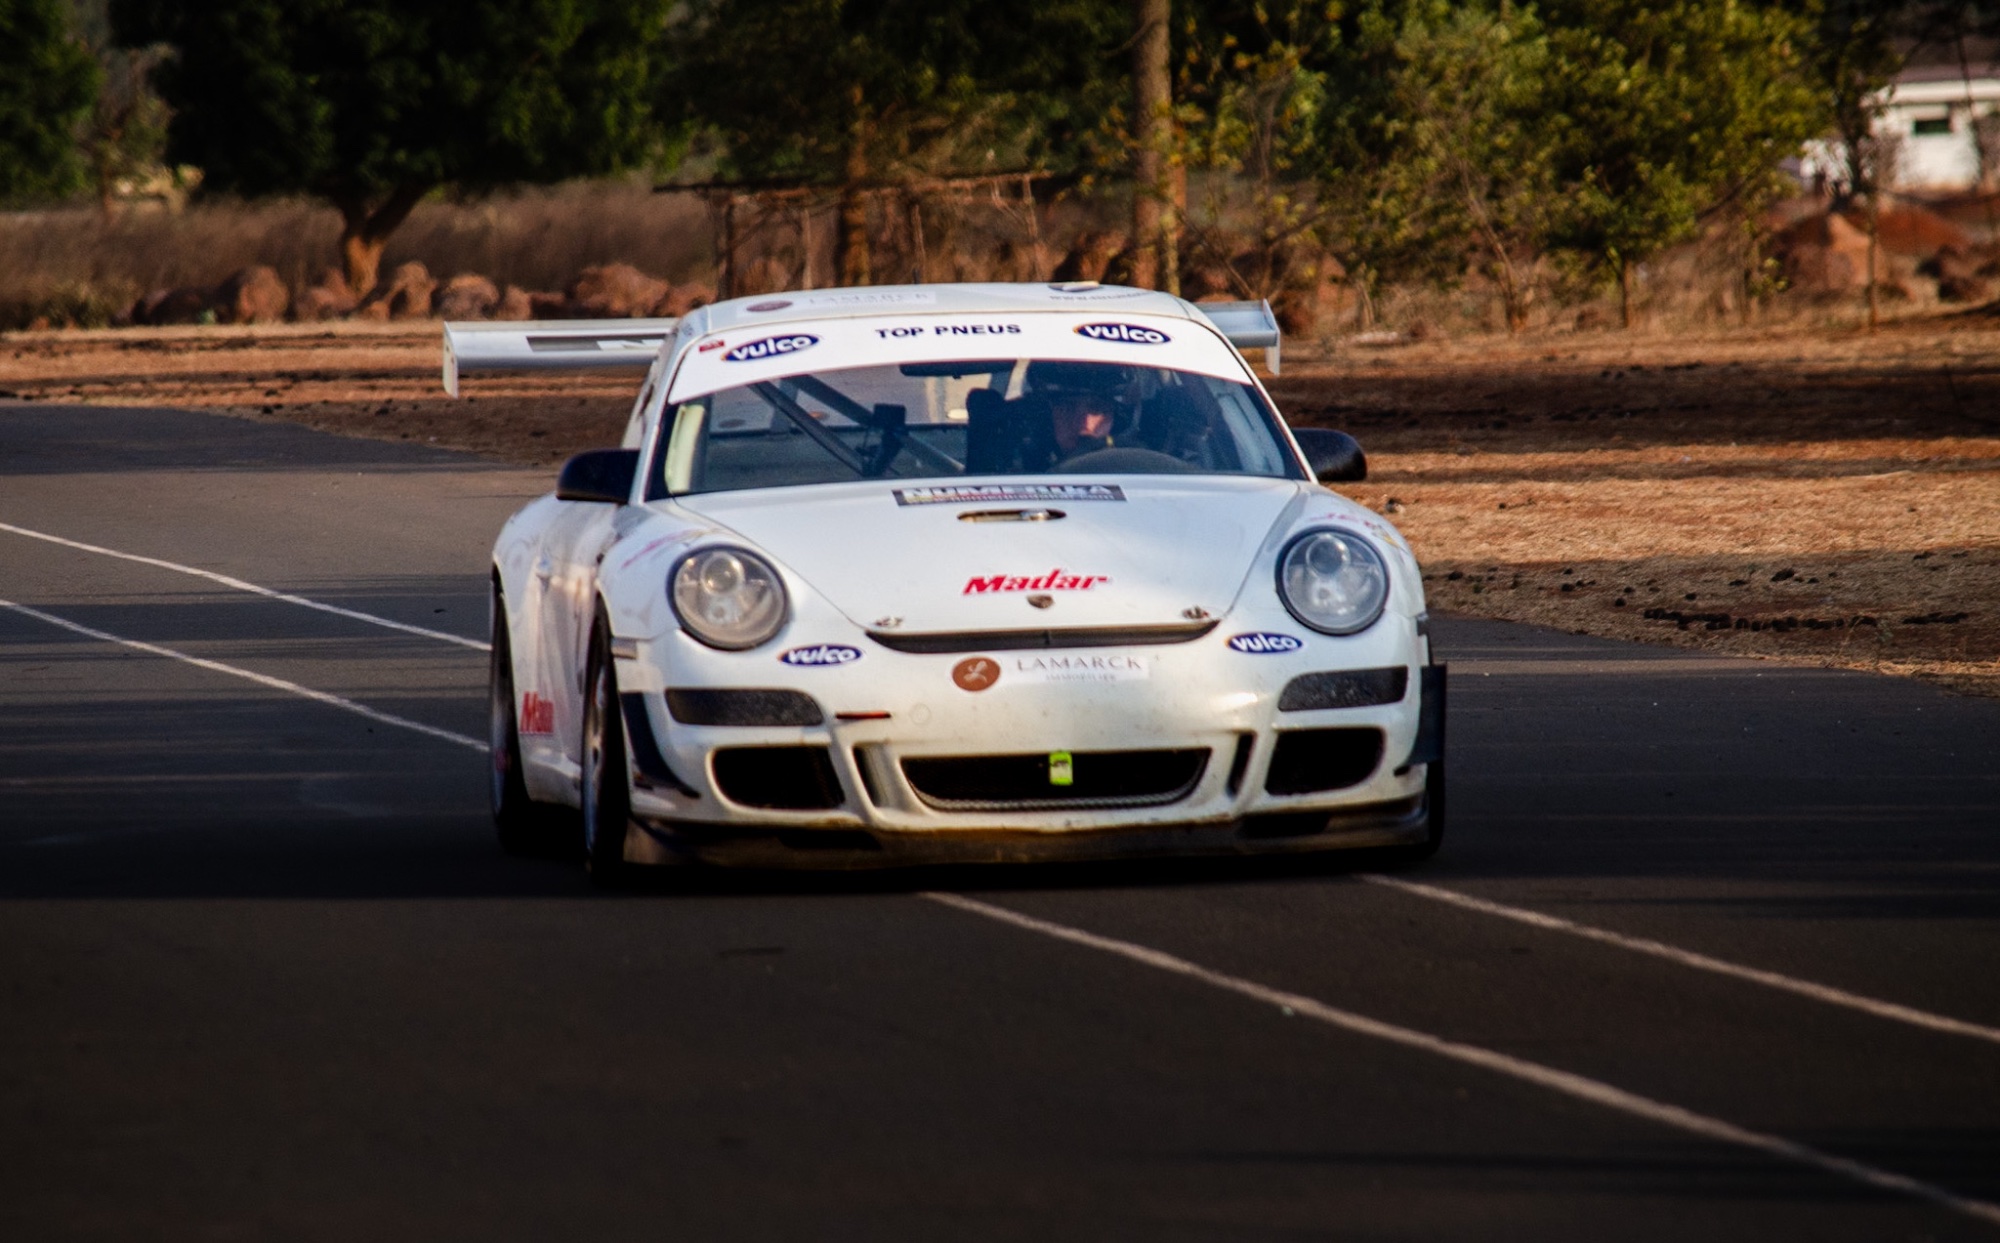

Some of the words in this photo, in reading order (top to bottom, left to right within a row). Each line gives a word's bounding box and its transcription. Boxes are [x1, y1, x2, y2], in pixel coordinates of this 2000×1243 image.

[876, 327, 924, 339] TOP
[935, 324, 1021, 336] PNEUS
[1085, 323, 1164, 344] vulco
[731, 334, 813, 361] vulco
[963, 568, 1108, 595] Madar
[1231, 633, 1299, 652] vulco
[788, 645, 857, 663] vulco
[1017, 656, 1142, 671] LAMARCK
